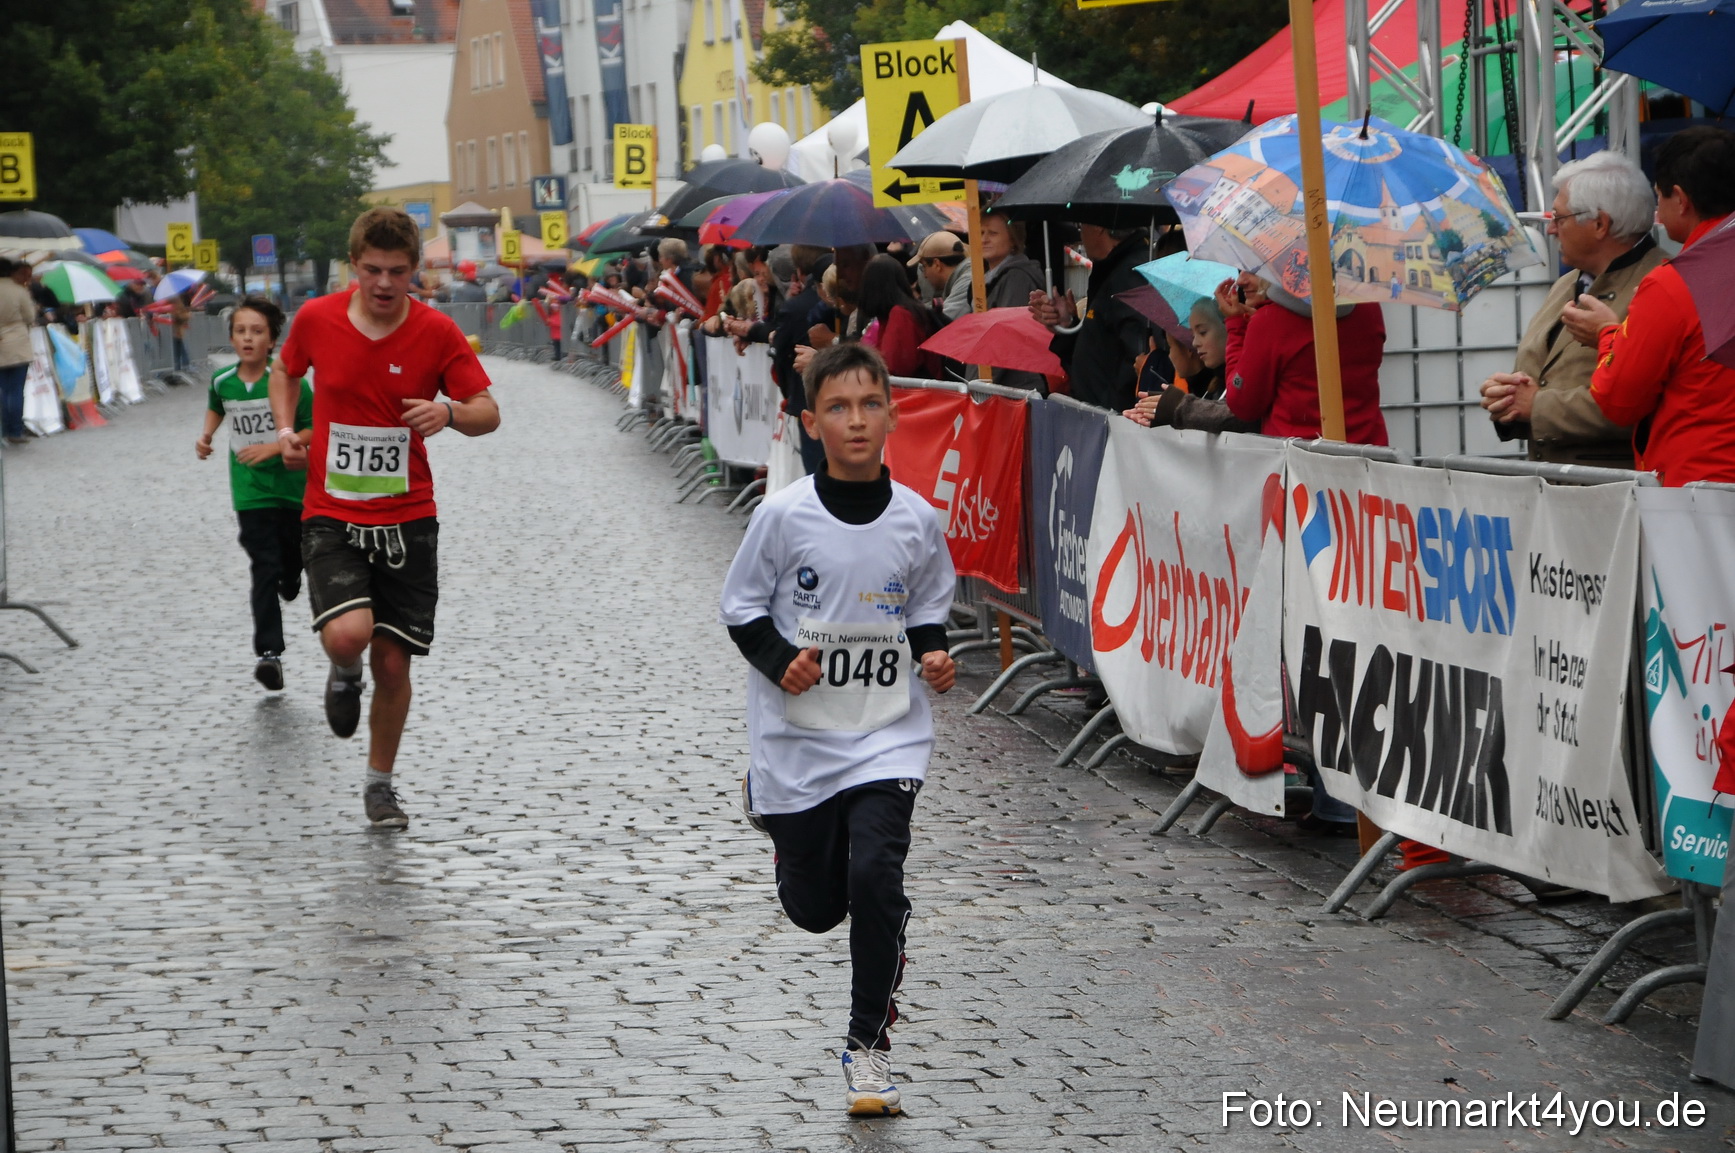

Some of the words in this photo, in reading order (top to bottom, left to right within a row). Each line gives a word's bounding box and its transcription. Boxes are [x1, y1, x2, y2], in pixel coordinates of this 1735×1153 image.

[874, 46, 957, 80] Block
[619, 126, 653, 139] Block
[895, 90, 936, 155] A
[1, 153, 20, 184] B
[625, 144, 646, 175] B
[172, 232, 186, 252] C
[548, 222, 561, 242] C
[200, 249, 211, 264] D
[505, 240, 517, 255] D
[232, 411, 276, 435] 4023
[331, 430, 355, 440] PARTL
[357, 434, 396, 442] Neumarkt
[335, 442, 401, 473] 5153
[1328, 487, 1517, 637] INTERSPORT
[793, 590, 821, 604] PARTL
[793, 600, 821, 610] Neumarkt
[798, 628, 836, 643] PARTL
[838, 634, 893, 643] Neumarkt
[1670, 824, 1729, 860] Servic
